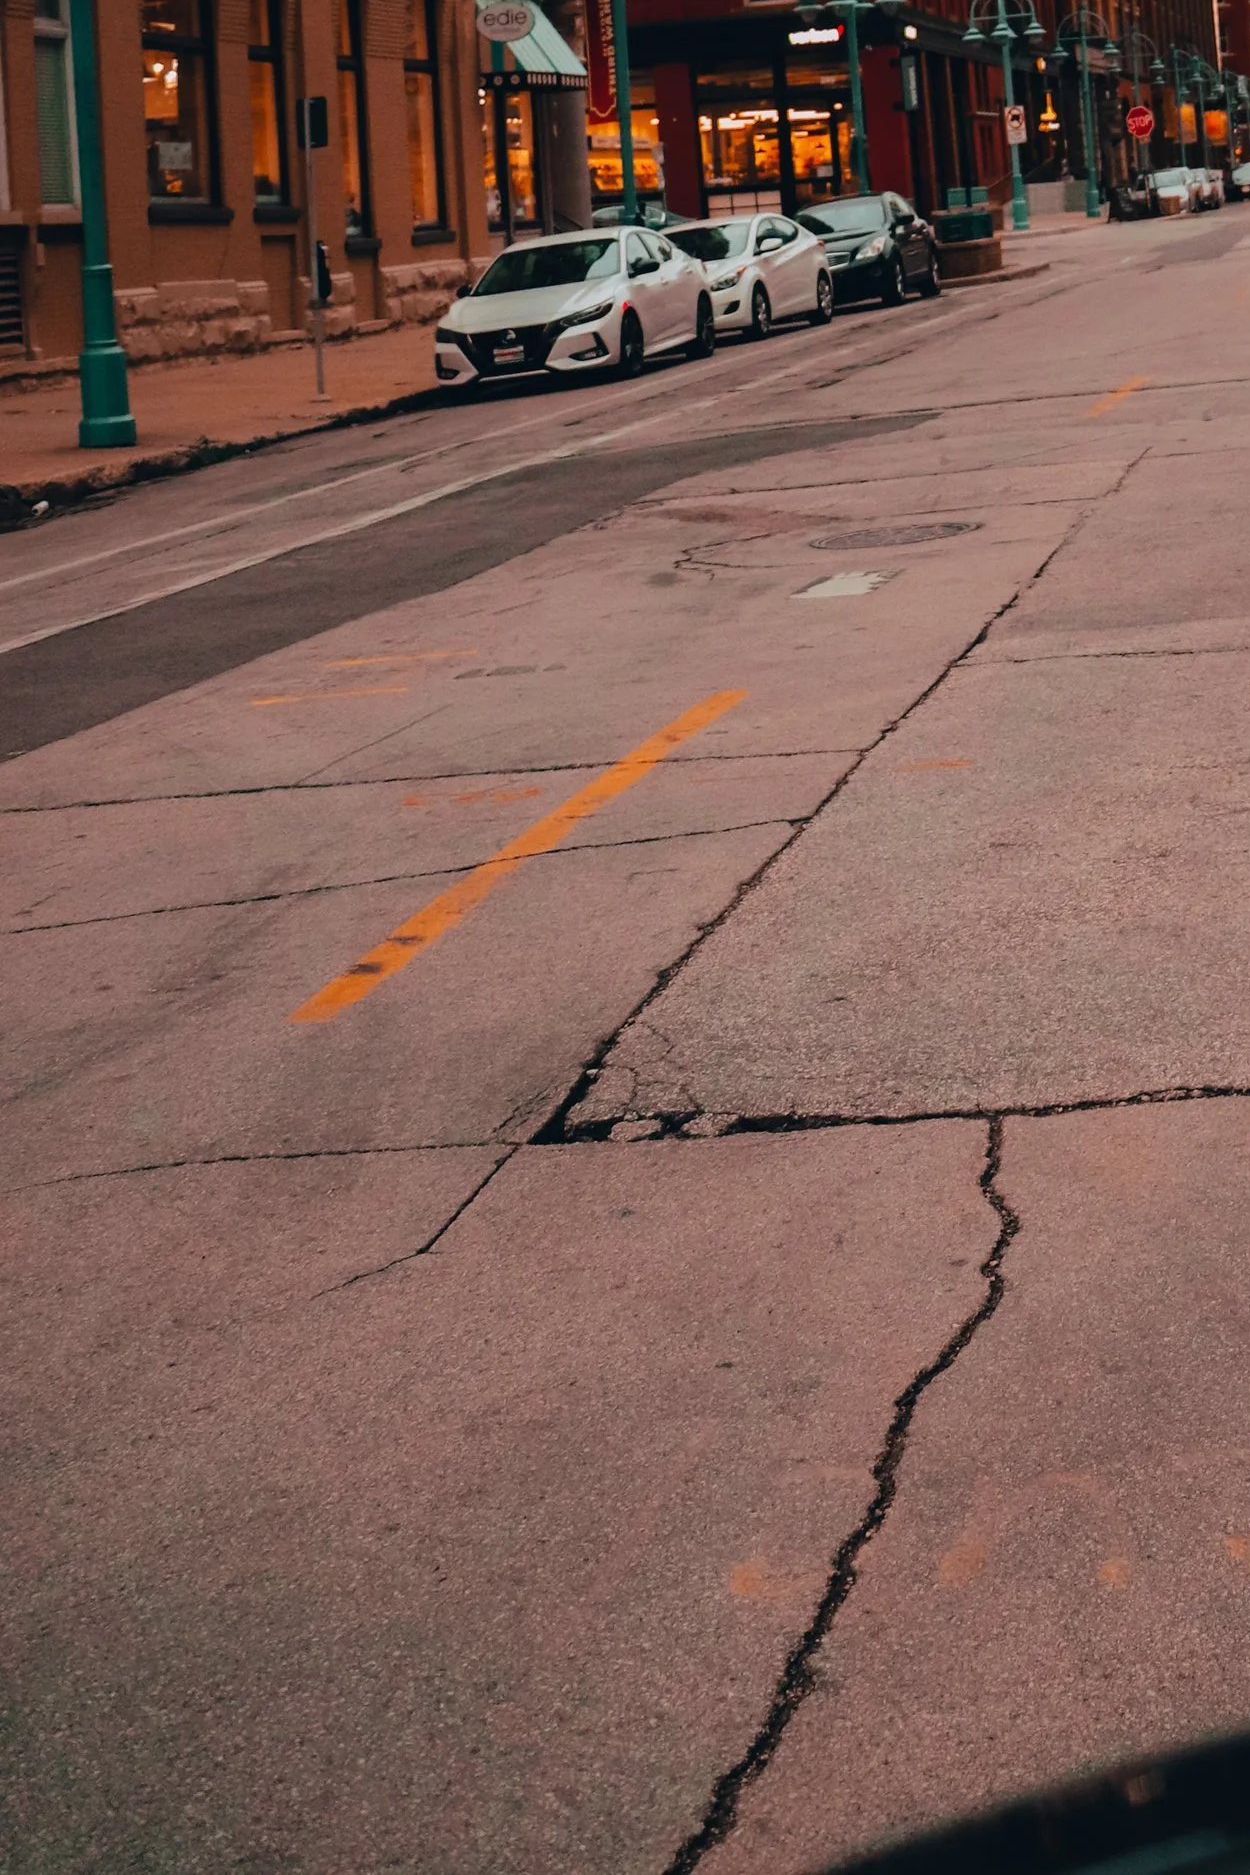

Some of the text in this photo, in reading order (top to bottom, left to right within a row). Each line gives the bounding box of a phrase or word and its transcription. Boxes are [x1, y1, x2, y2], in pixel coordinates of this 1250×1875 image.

[484, 9, 527, 26] edie
[607, 45, 617, 95] THIRD
[1127, 114, 1150, 131] STOP
